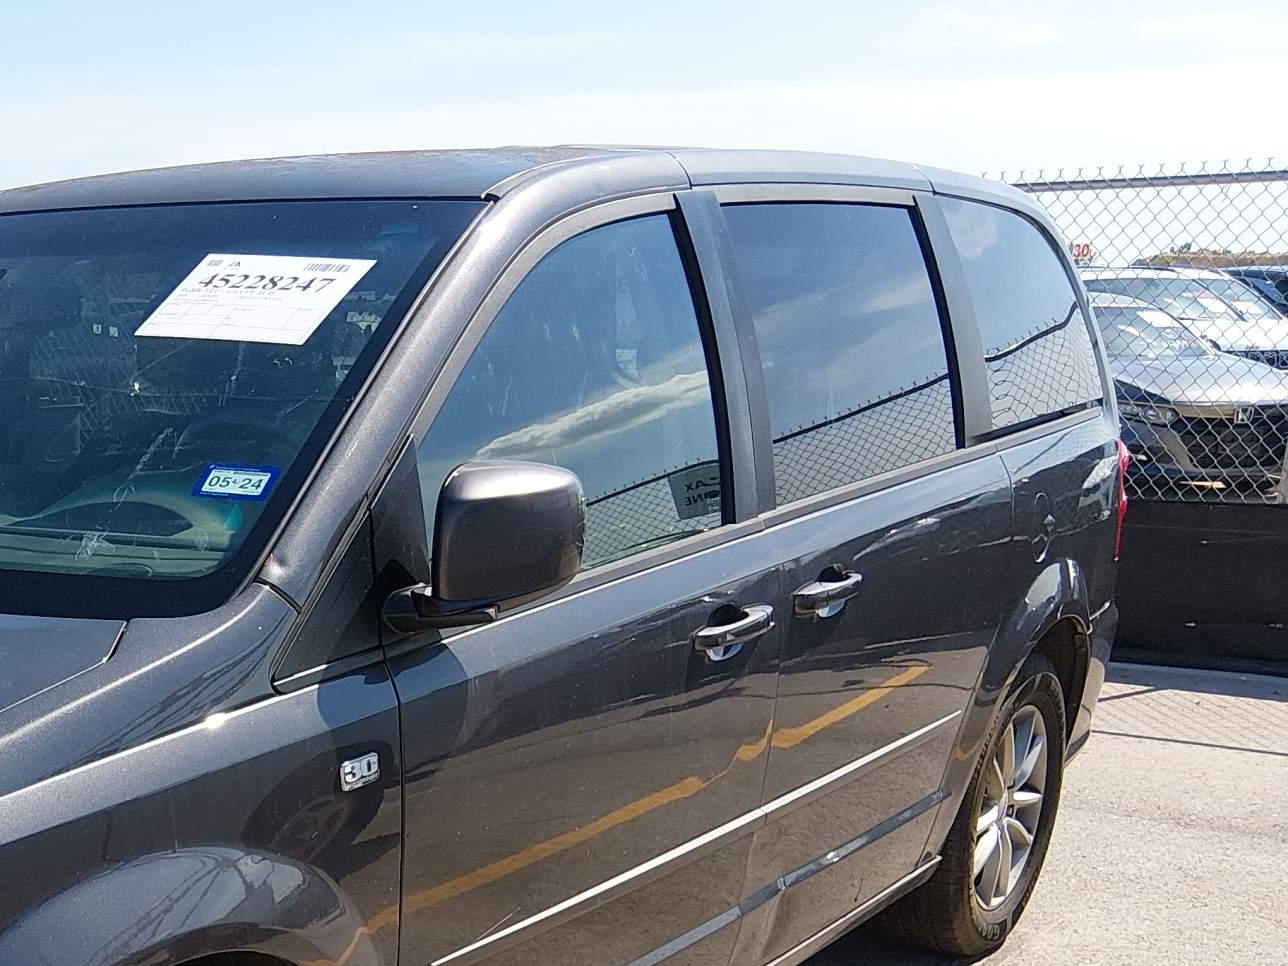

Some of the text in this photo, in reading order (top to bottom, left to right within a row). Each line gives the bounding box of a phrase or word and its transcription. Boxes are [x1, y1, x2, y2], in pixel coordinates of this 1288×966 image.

[197, 272, 337, 293] 45228247
[208, 475, 264, 490] 05 24
[344, 755, 379, 783] 30
